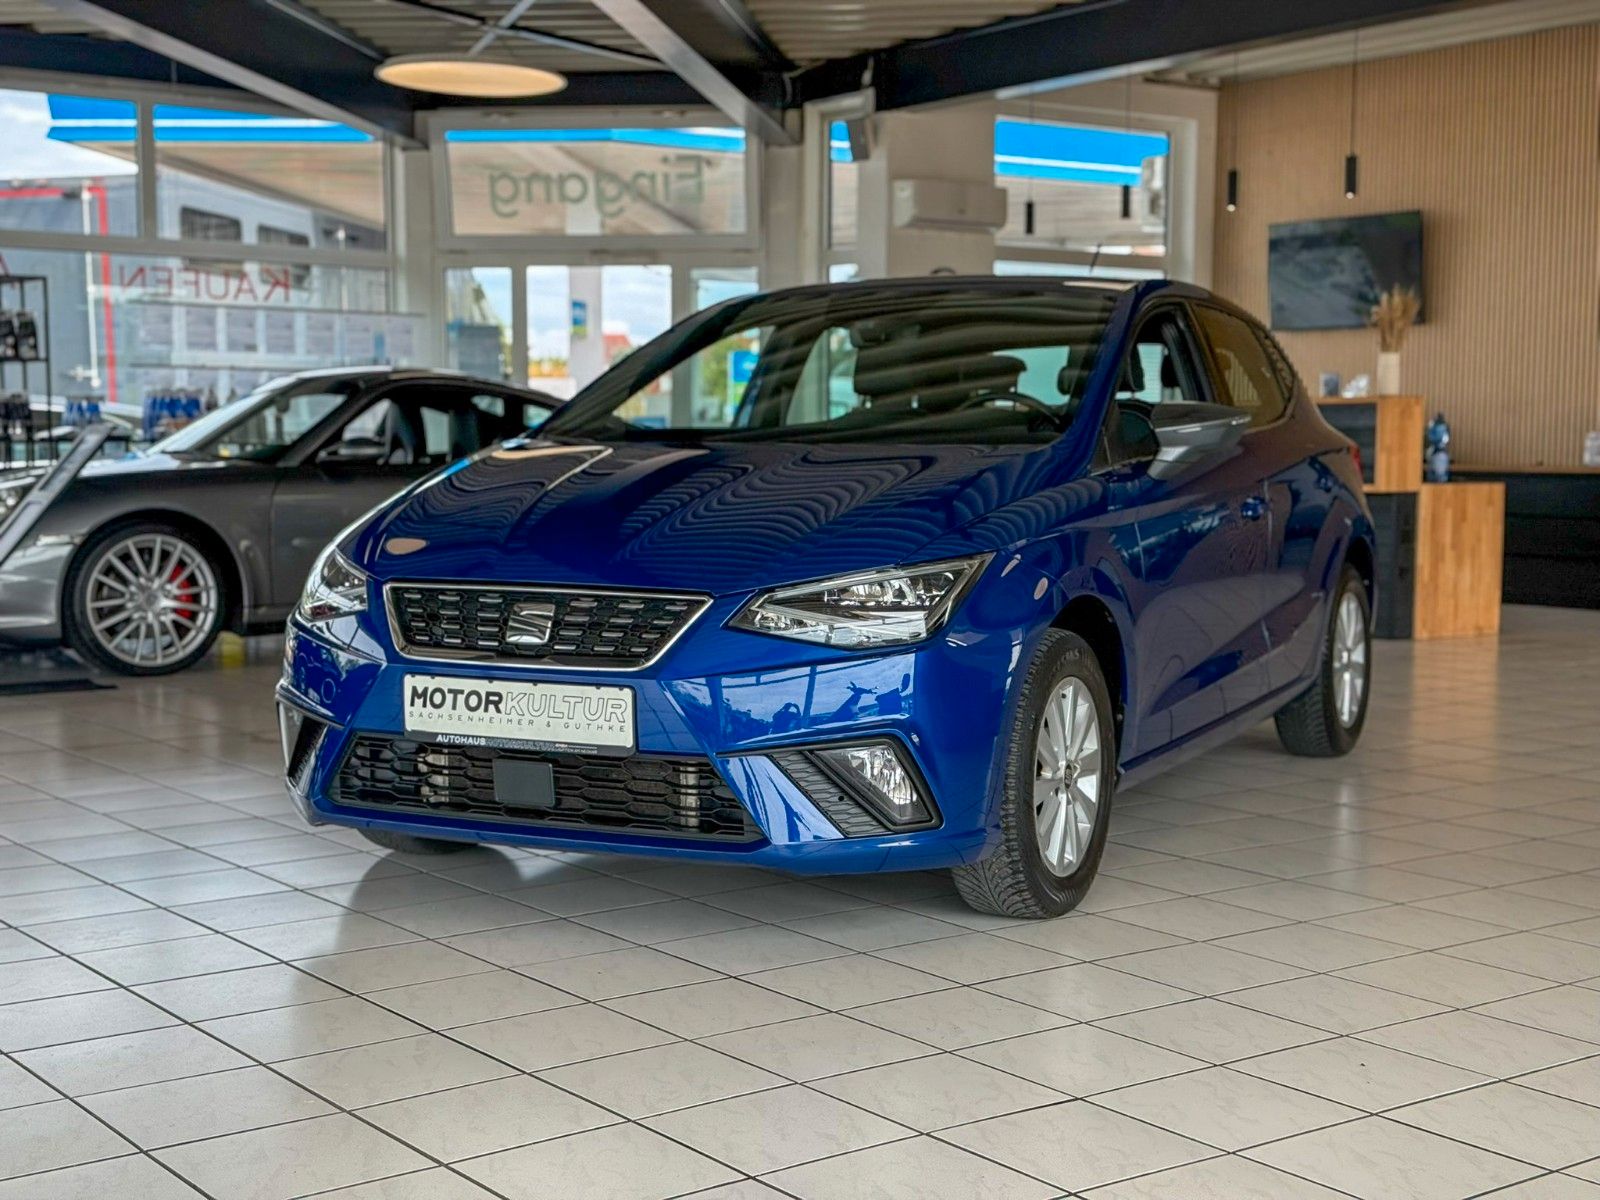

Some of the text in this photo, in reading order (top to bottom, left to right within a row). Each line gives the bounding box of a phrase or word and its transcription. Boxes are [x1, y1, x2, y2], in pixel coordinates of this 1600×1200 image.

[410, 685, 628, 723] MOTORKULTUR
[408, 711, 535, 727] SACHSENHEIMER
[563, 722, 626, 733] GUTHKE
[435, 734, 487, 746] AUTOHAUS
